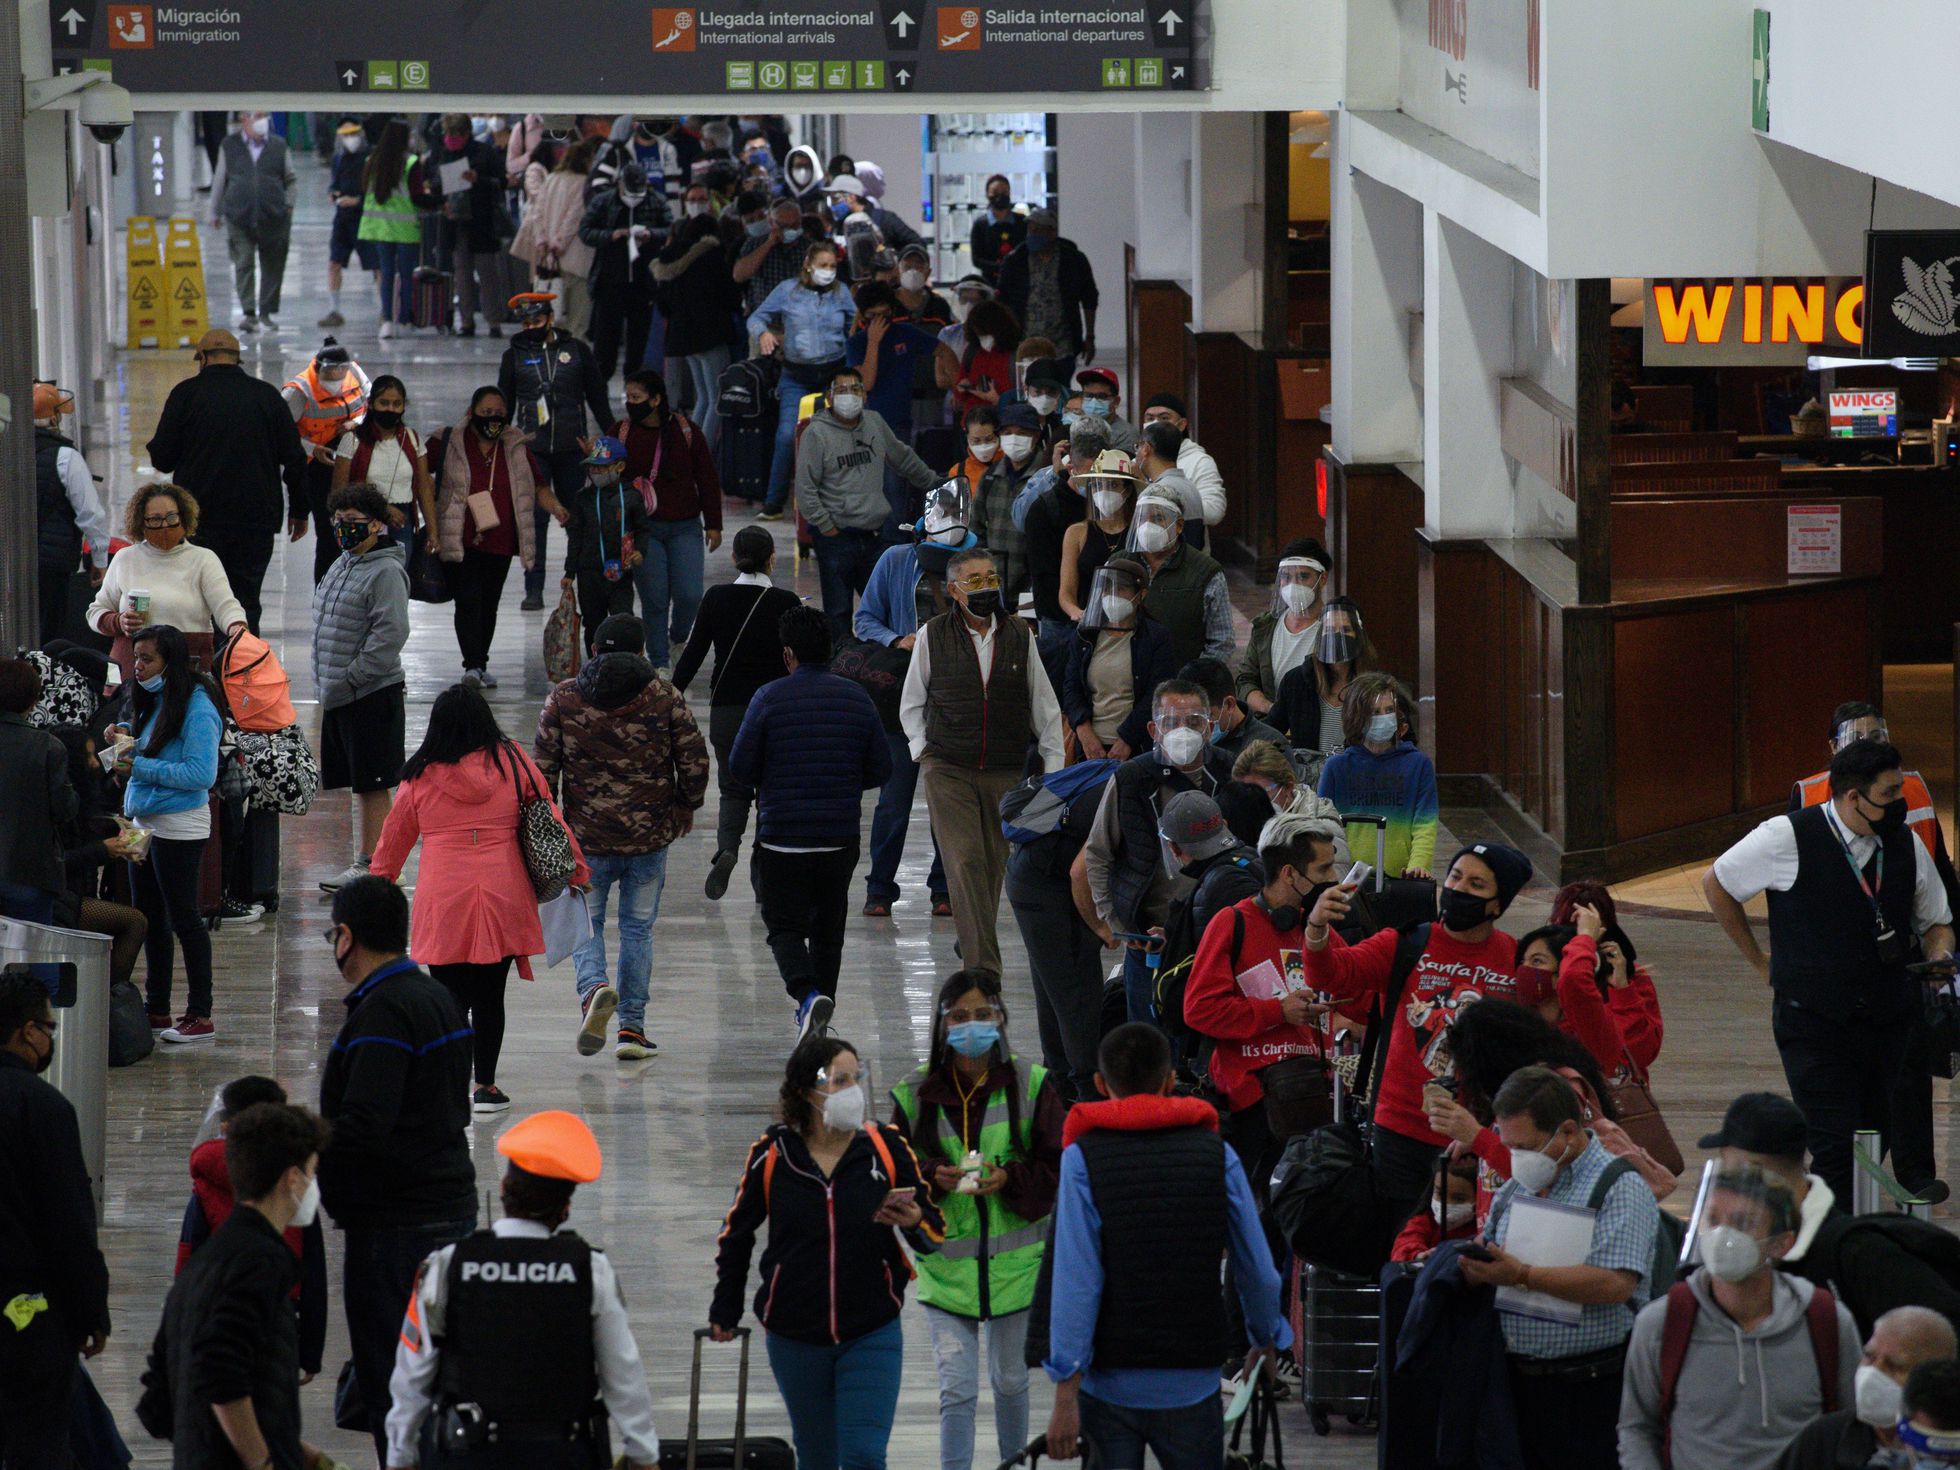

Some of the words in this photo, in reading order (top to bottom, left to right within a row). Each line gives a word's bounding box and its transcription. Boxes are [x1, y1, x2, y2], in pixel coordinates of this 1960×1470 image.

[157, 8, 241, 26] Migración
[700, 11, 765, 29] Llegada
[769, 11, 874, 26] internacional
[985, 9, 1036, 24] Salida
[1040, 8, 1145, 23] internacional
[157, 29, 240, 43] Immigration
[700, 31, 783, 44] International
[786, 31, 836, 44] arrivals
[985, 29, 1069, 42] International
[1072, 28, 1145, 44] departures
[152, 136, 164, 196] TAXI
[1831, 392, 1895, 407] WINGS
[836, 450, 872, 469] PUMA
[1416, 953, 1472, 977] Santa
[1241, 1044, 1260, 1057] It's
[1262, 1041, 1314, 1056] Christmas
[461, 1261, 577, 1283] POLICÍA
